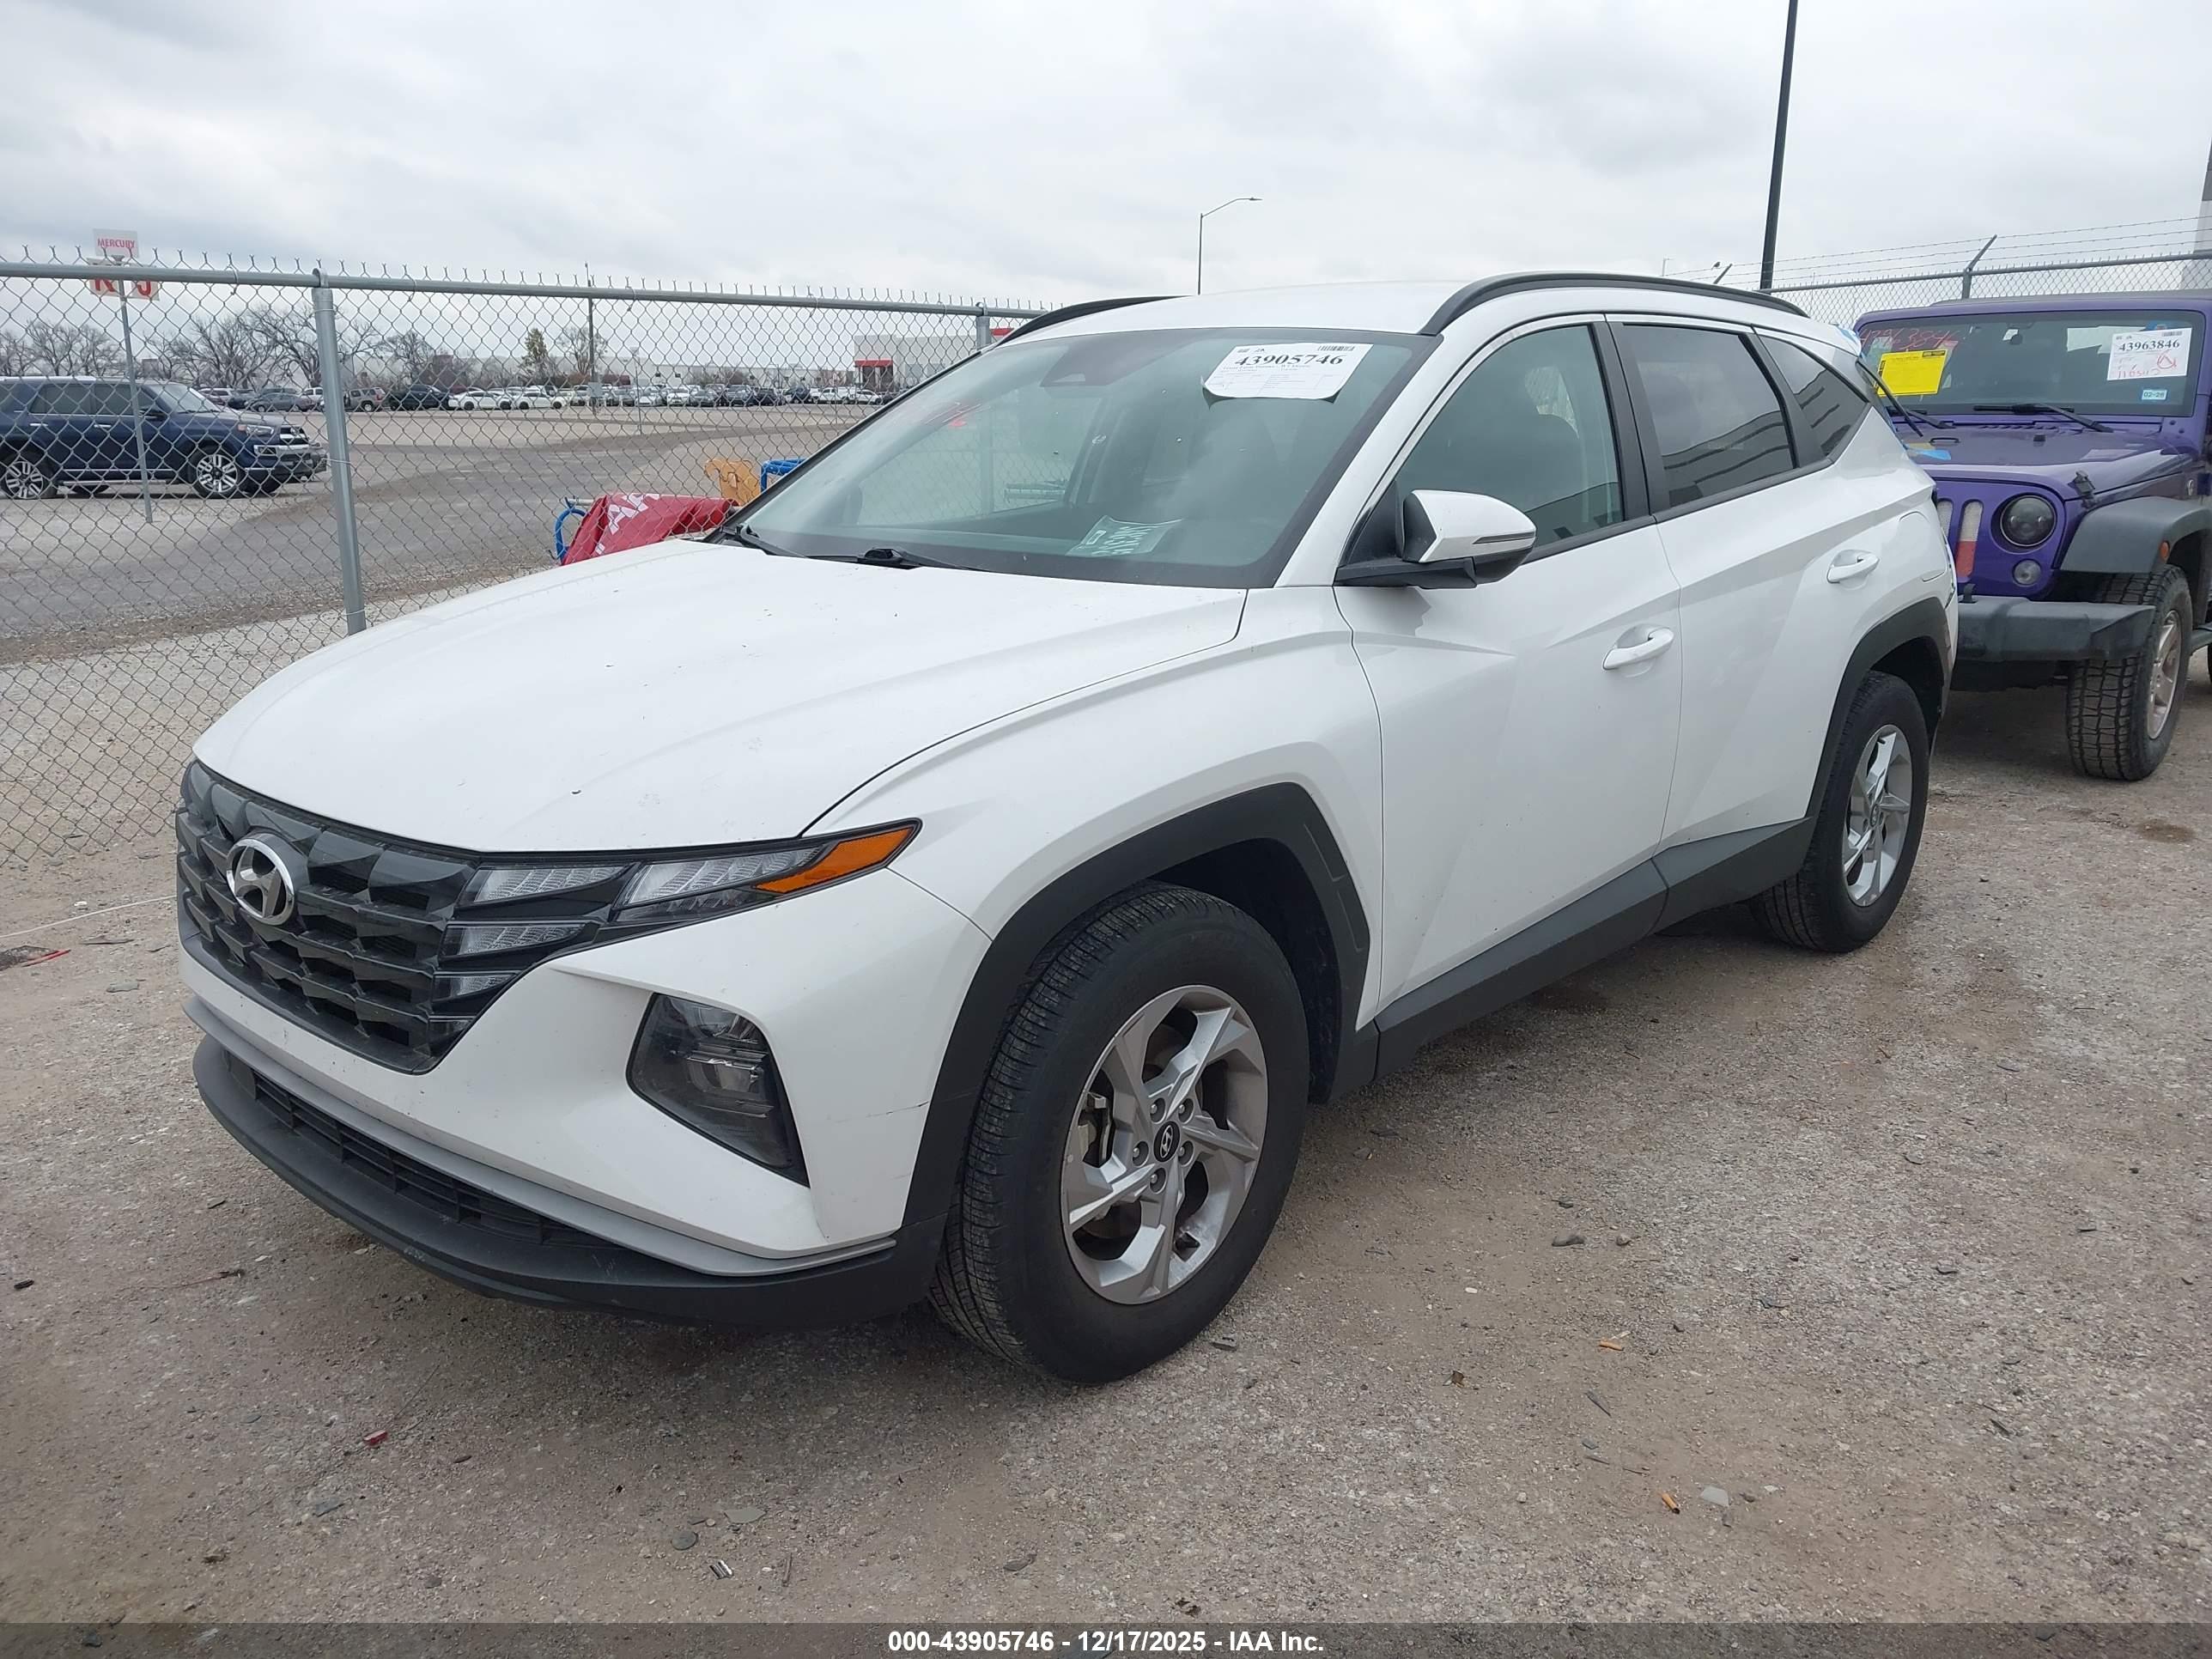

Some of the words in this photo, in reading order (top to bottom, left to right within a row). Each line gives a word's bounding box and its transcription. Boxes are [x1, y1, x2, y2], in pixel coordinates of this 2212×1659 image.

[97, 239, 135, 248] MERCURY
[2118, 338, 2180, 352] 43963846
[1235, 354, 1346, 366] 43905746
